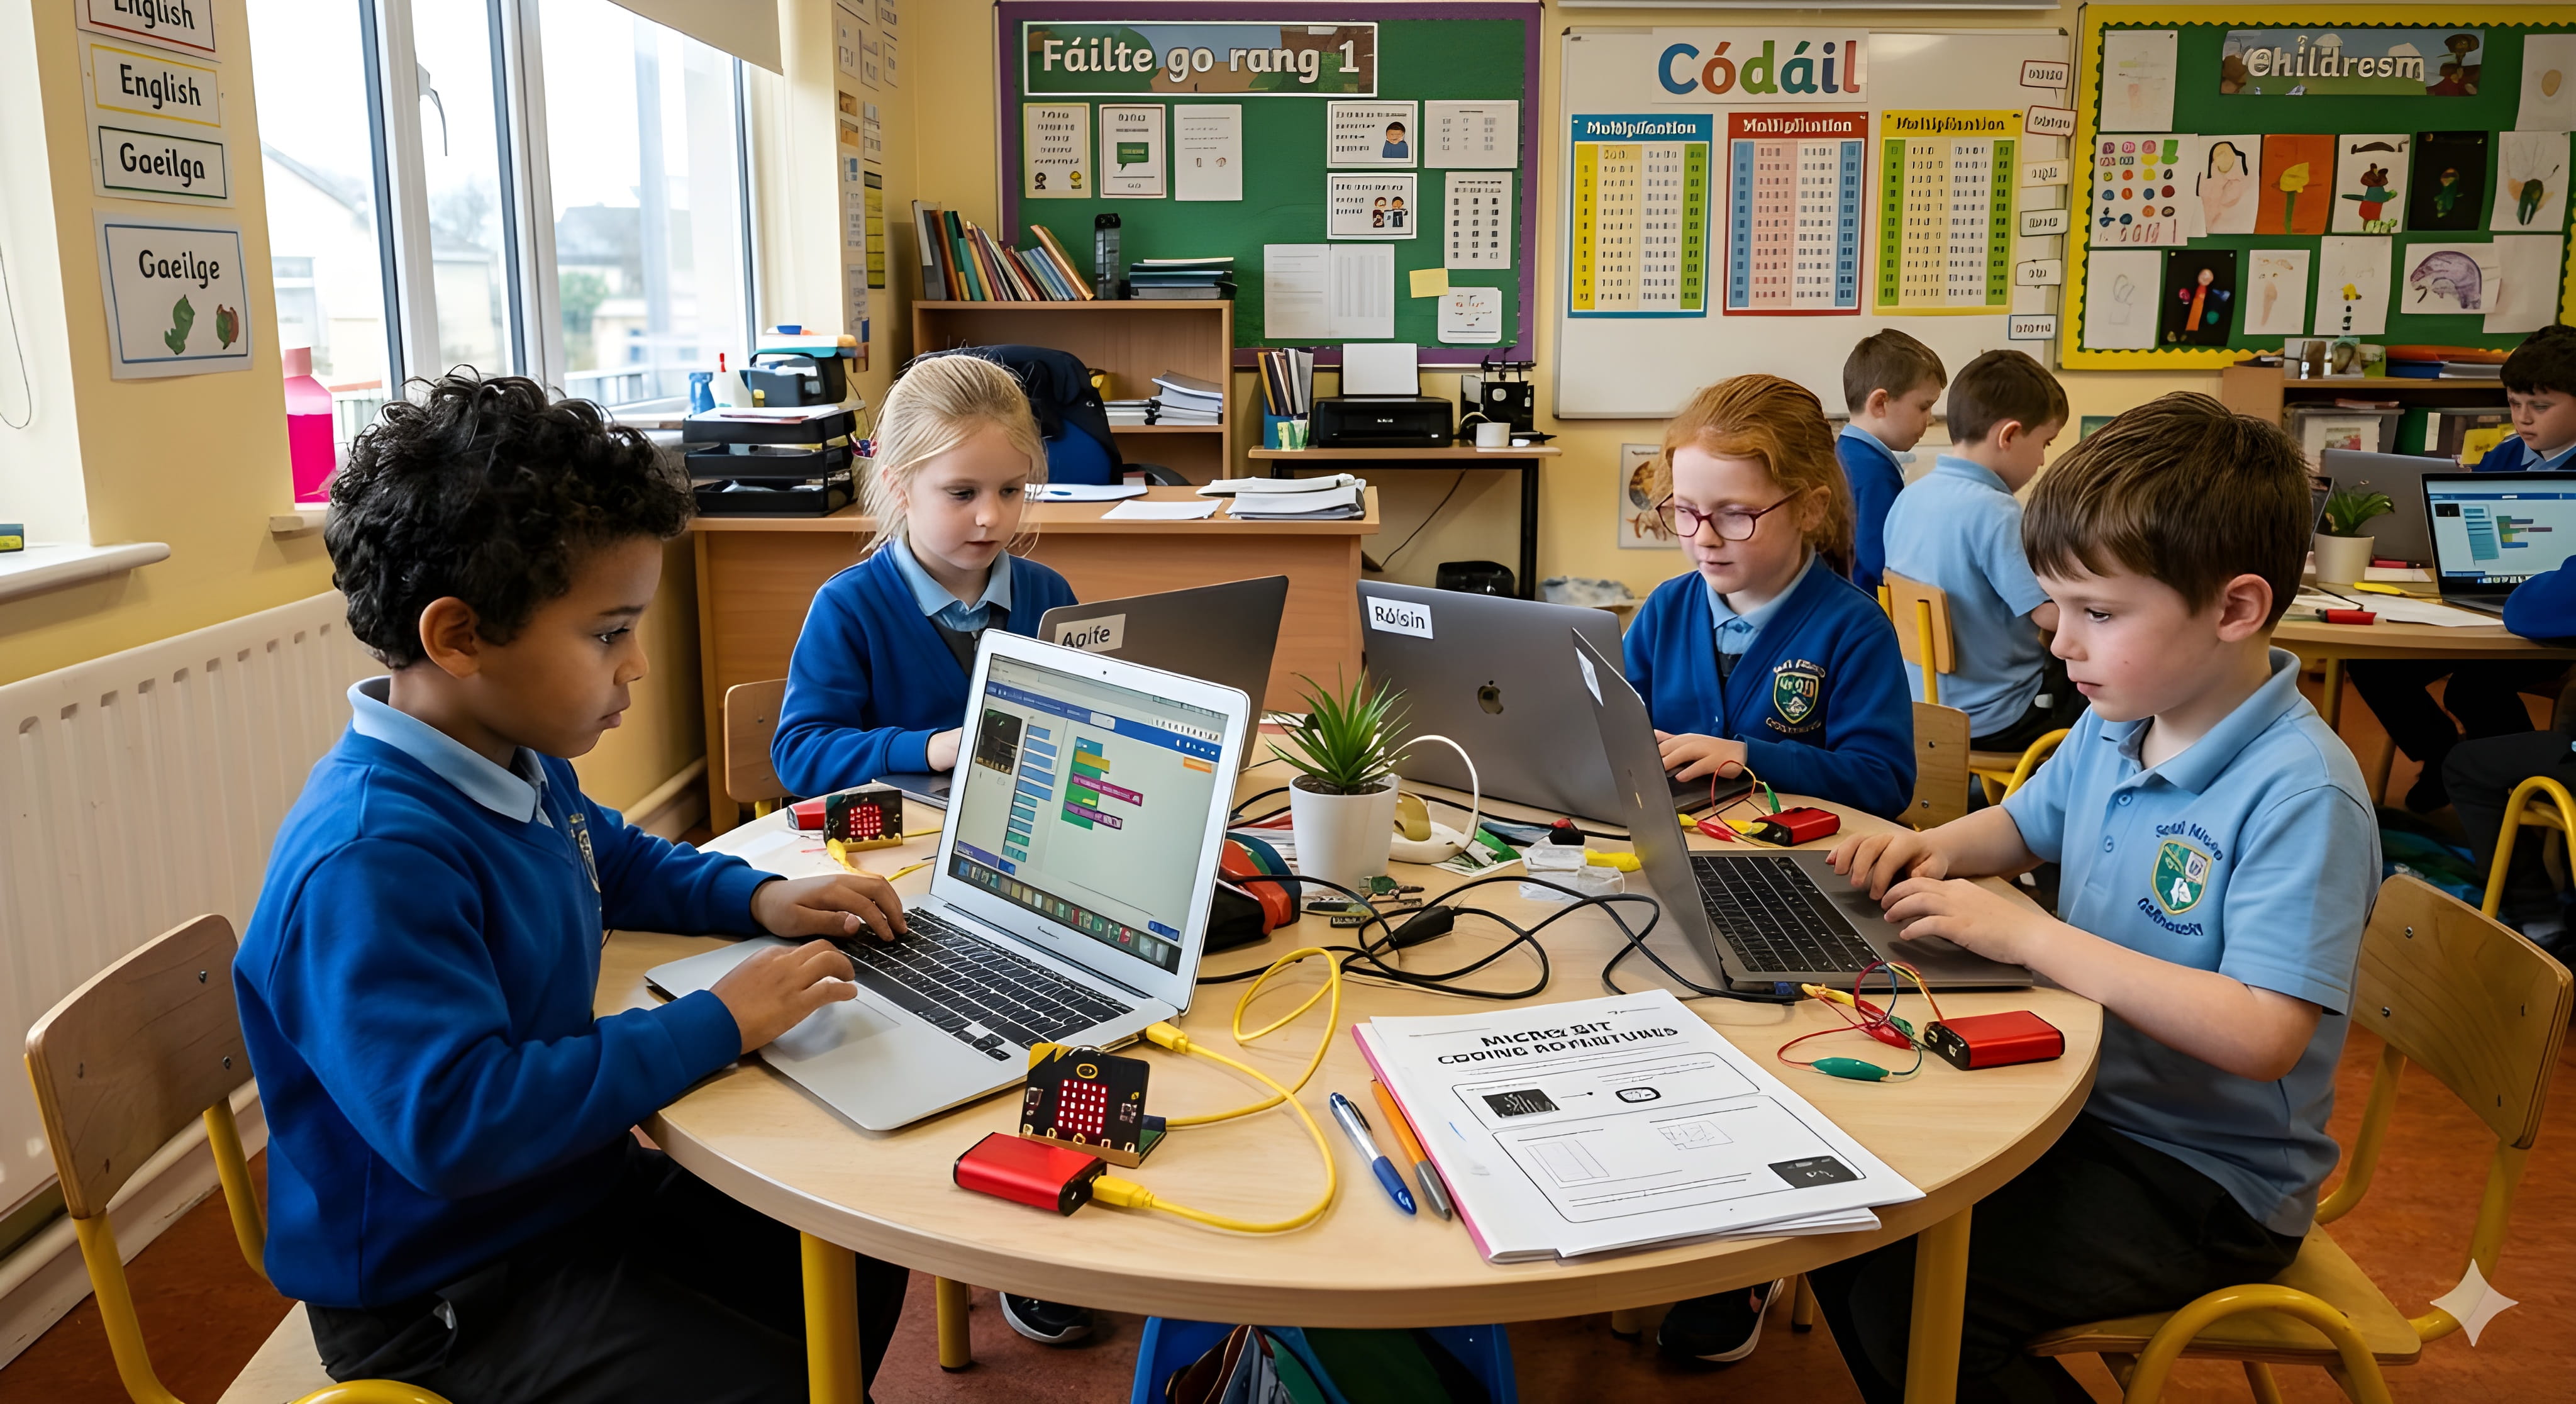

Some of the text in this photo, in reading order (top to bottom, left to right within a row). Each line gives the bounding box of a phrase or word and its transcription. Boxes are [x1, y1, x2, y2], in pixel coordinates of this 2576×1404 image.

[1043, 36, 1359, 84] Fáilte go rang 1
[1658, 40, 1860, 94] Códáil
[120, 64, 201, 109] English
[120, 142, 205, 187] Gaeilga
[139, 249, 219, 289] Gaeilge
